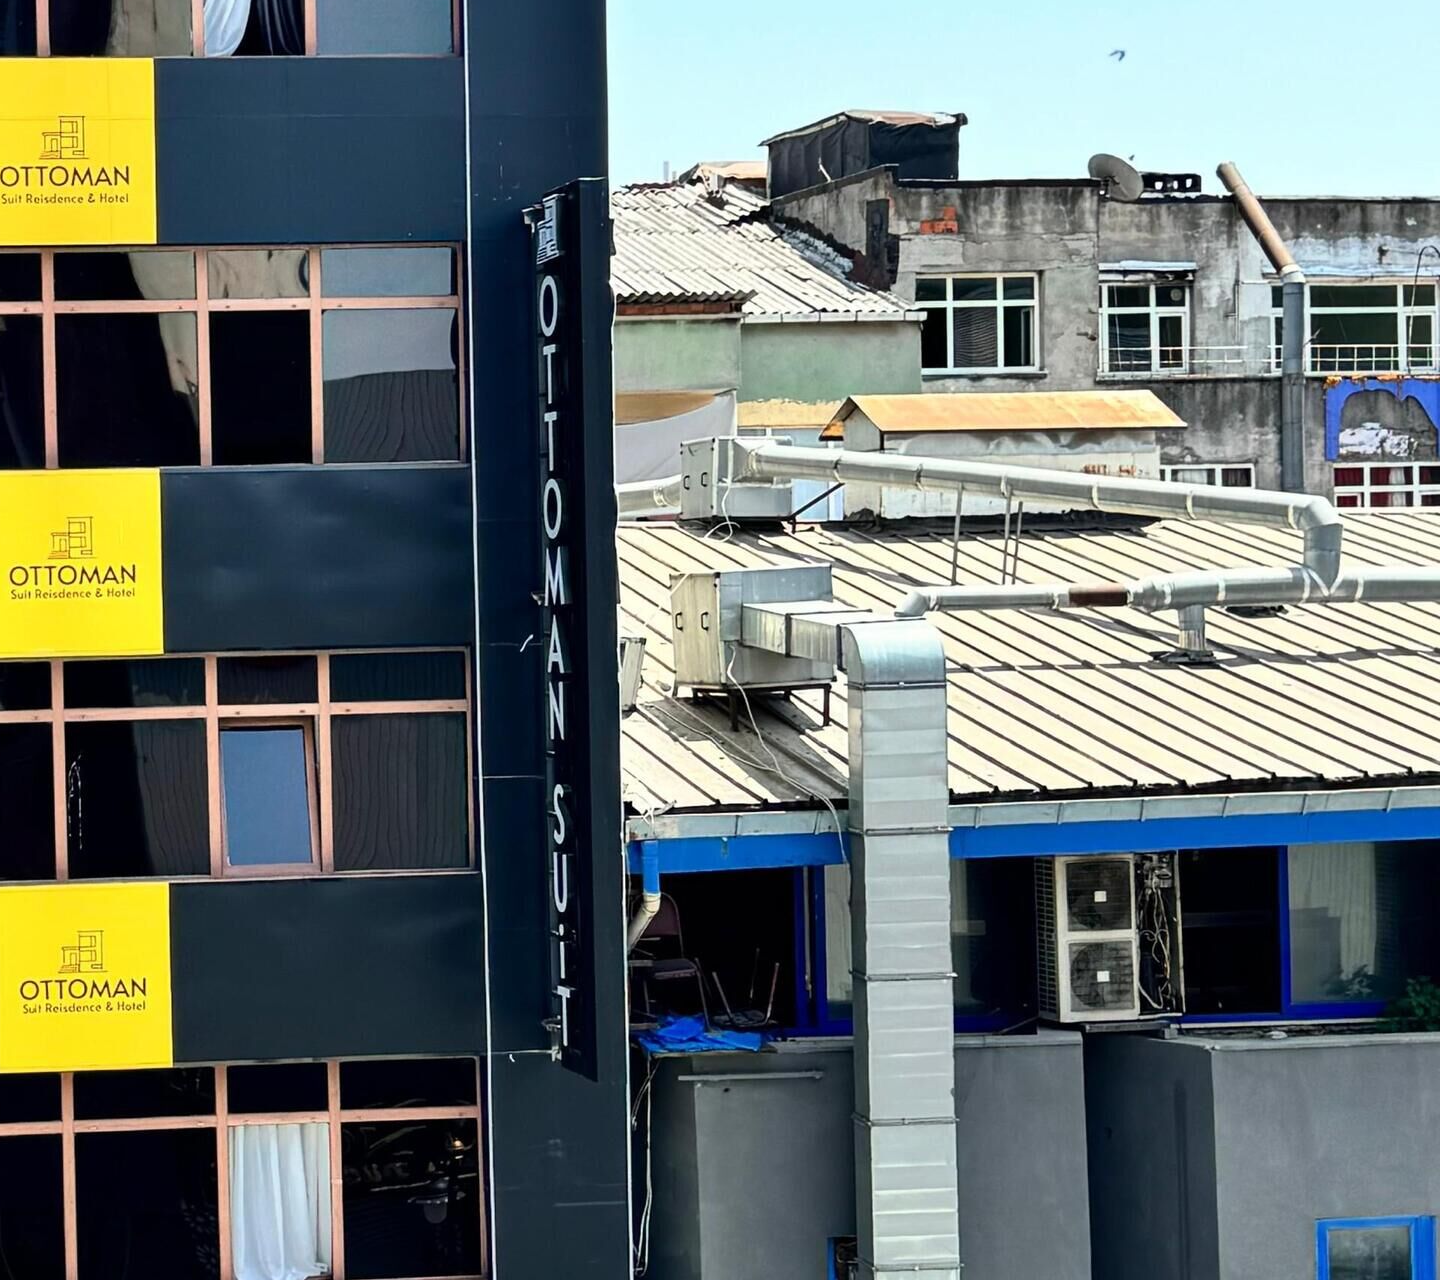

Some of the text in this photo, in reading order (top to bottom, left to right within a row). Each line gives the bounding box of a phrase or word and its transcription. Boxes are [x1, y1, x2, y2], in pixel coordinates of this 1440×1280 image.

[0, 166, 130, 187] OTTOMAN
[87, 193, 96, 204] &
[538, 274, 567, 741] OTTOMAN
[9, 564, 136, 586] OTTOMAN
[95, 587, 103, 598] &
[19, 977, 147, 1000] OTTOMAN
[105, 1001, 113, 1012] &
